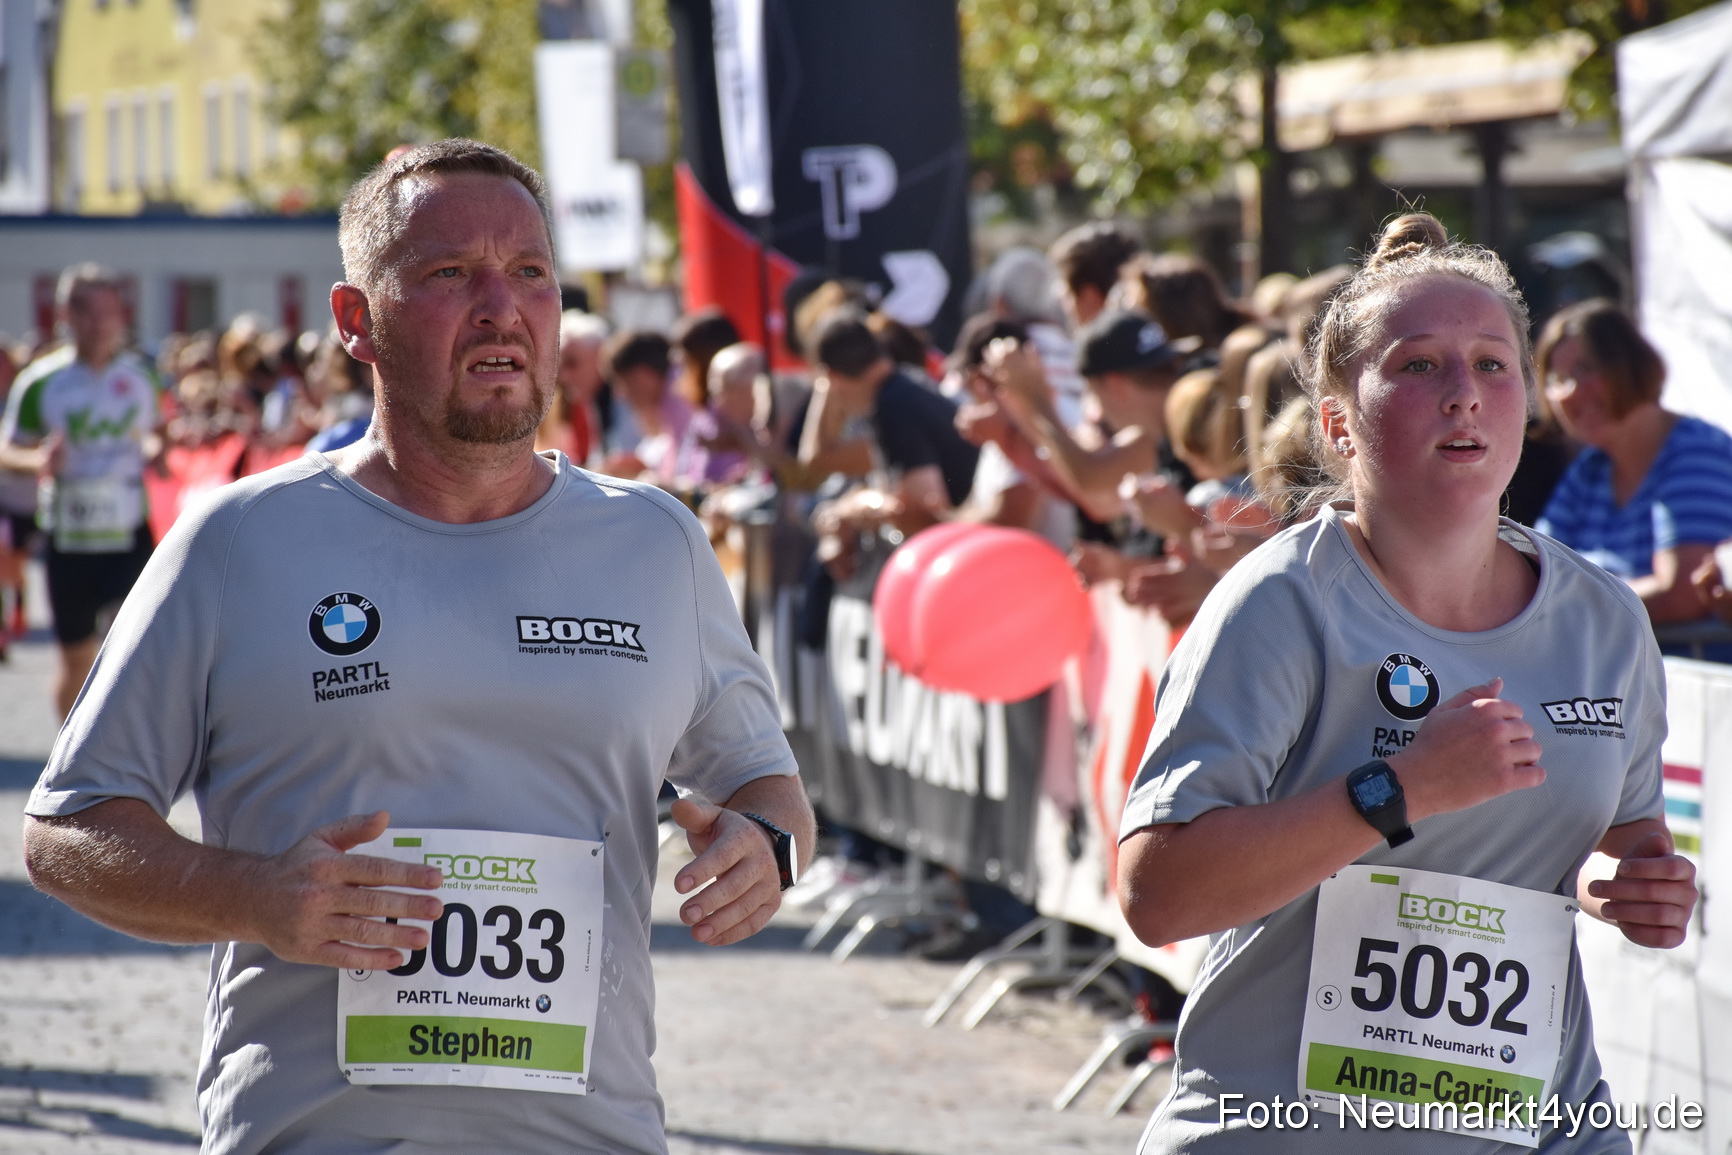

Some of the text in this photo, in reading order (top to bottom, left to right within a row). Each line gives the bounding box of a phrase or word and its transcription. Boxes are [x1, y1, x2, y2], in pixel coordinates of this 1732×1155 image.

[314, 594, 373, 617] BMW
[516, 616, 646, 652] BOCK
[518, 645, 648, 662] inspired by smart concepts
[1384, 655, 1431, 674] BMW
[312, 661, 389, 689] PARTL
[315, 679, 391, 702] Neumarkt
[1374, 727, 1419, 748] PAR
[1555, 726, 1587, 736] inspired
[1588, 727, 1598, 737] by
[424, 854, 537, 884] BOCK
[461, 881, 471, 890] by
[501, 886, 538, 894] concepts
[1399, 893, 1506, 935] BOCK
[1397, 919, 1505, 944] inspired by smart concepts
[1323, 991, 1333, 1004] S
[1351, 937, 1530, 1036] 5032
[397, 990, 452, 1004] PARTL
[457, 991, 530, 1009] Neumarkt
[408, 1024, 533, 1063] Stephan
[1363, 1025, 1495, 1058] PARTL Neumarkt
